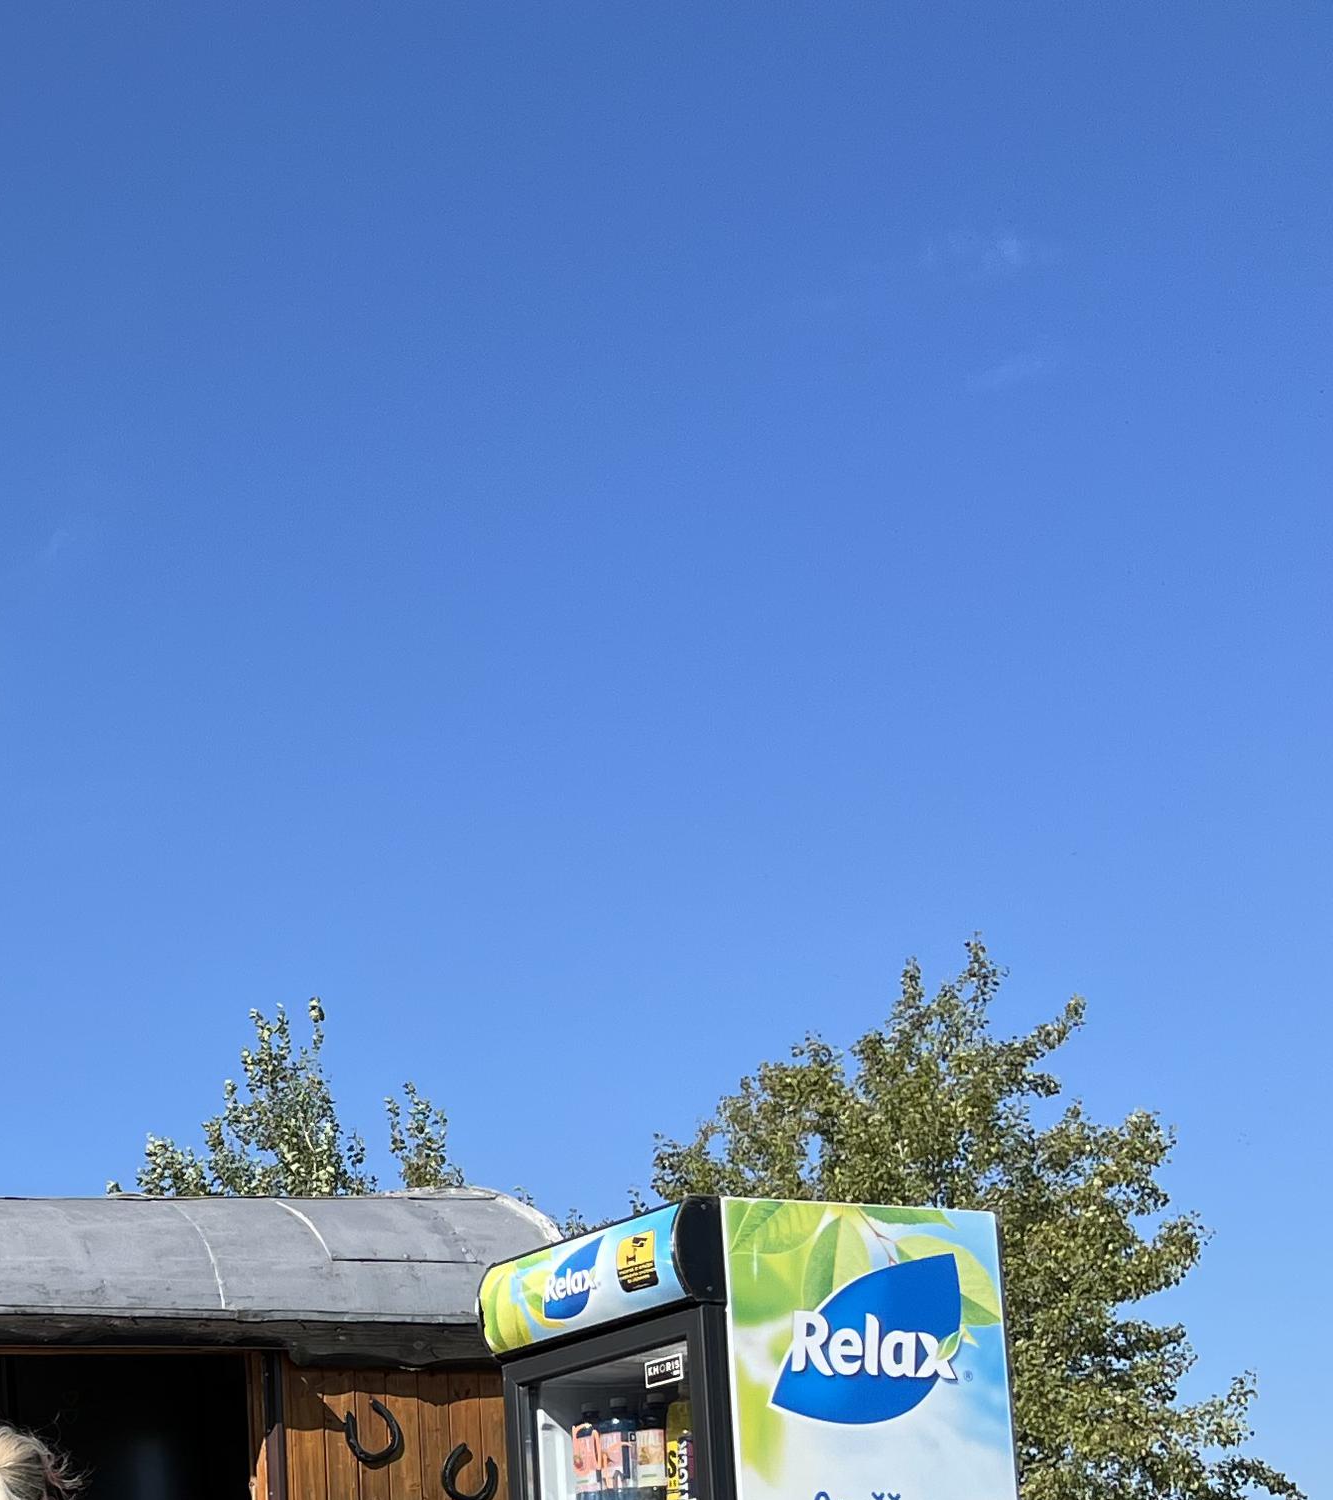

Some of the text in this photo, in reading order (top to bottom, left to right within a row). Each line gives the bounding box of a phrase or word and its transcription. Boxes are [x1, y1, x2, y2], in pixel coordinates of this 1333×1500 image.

[544, 1267, 597, 1303] Relax
[791, 1310, 958, 1380] Relax
[647, 1360, 680, 1377] KHORIS
